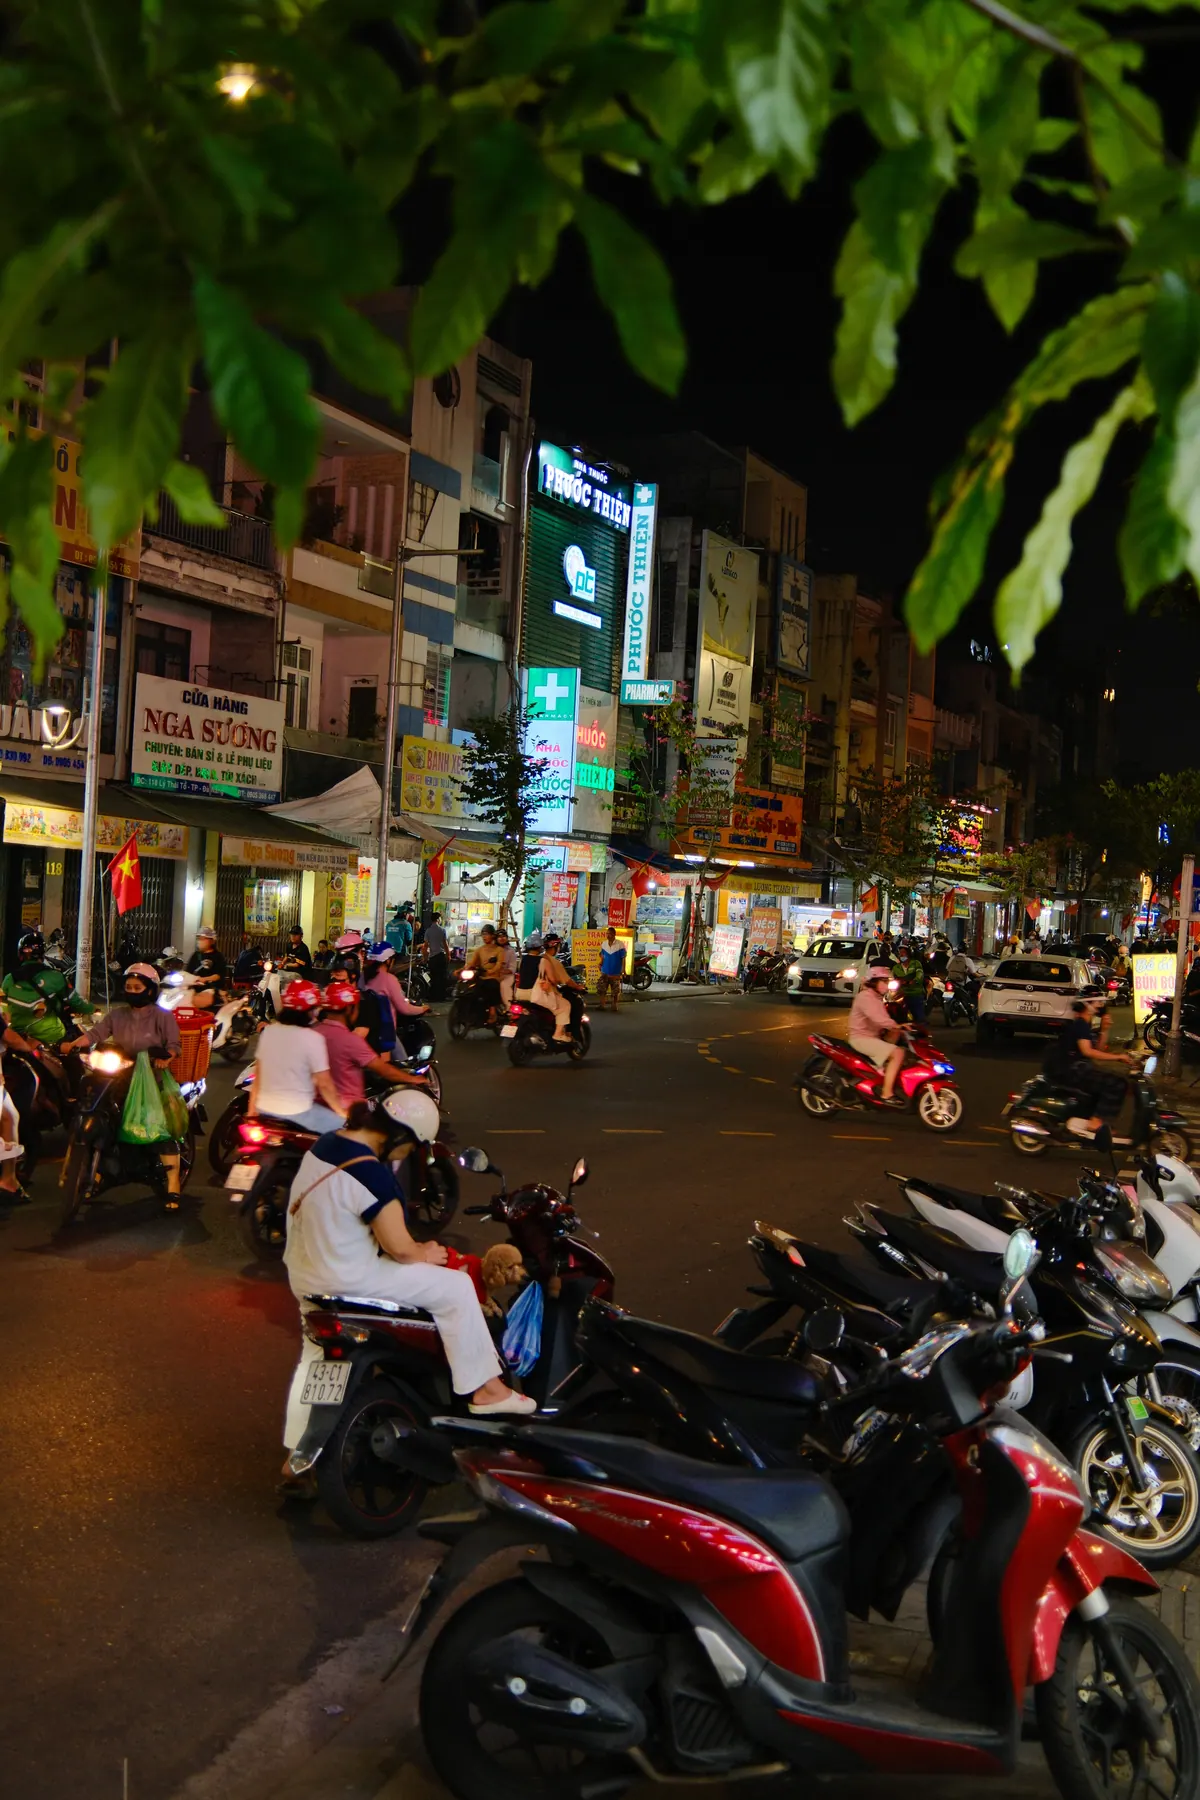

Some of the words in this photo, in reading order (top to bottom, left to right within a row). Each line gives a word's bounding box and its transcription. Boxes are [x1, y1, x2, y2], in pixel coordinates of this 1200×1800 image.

[574, 459, 587, 473] NHÀ
[588, 467, 608, 484] THUỐC
[545, 464, 592, 507] PHƯỚC
[593, 488, 631, 529] THIỆN
[632, 514, 652, 585] THIỆN
[626, 593, 645, 674] PHƯỚC
[182, 688, 208, 708] CỬA
[213, 696, 248, 715] HÀNG
[144, 708, 194, 740] NGA
[202, 718, 278, 754] SƯƠNG
[145, 741, 183, 757] CHUYÊN:
[185, 746, 204, 760] BÁN
[427, 747, 450, 773] BÁNH
[244, 841, 262, 861] Nga
[46, 861, 63, 876] 118
[556, 859, 562, 869] 8
[1135, 977, 1157, 994] BÚN
[1088, 1324, 1114, 1337] HONDA
[312, 1364, 343, 1381] 43-C1
[303, 1384, 342, 1402] 810.72
